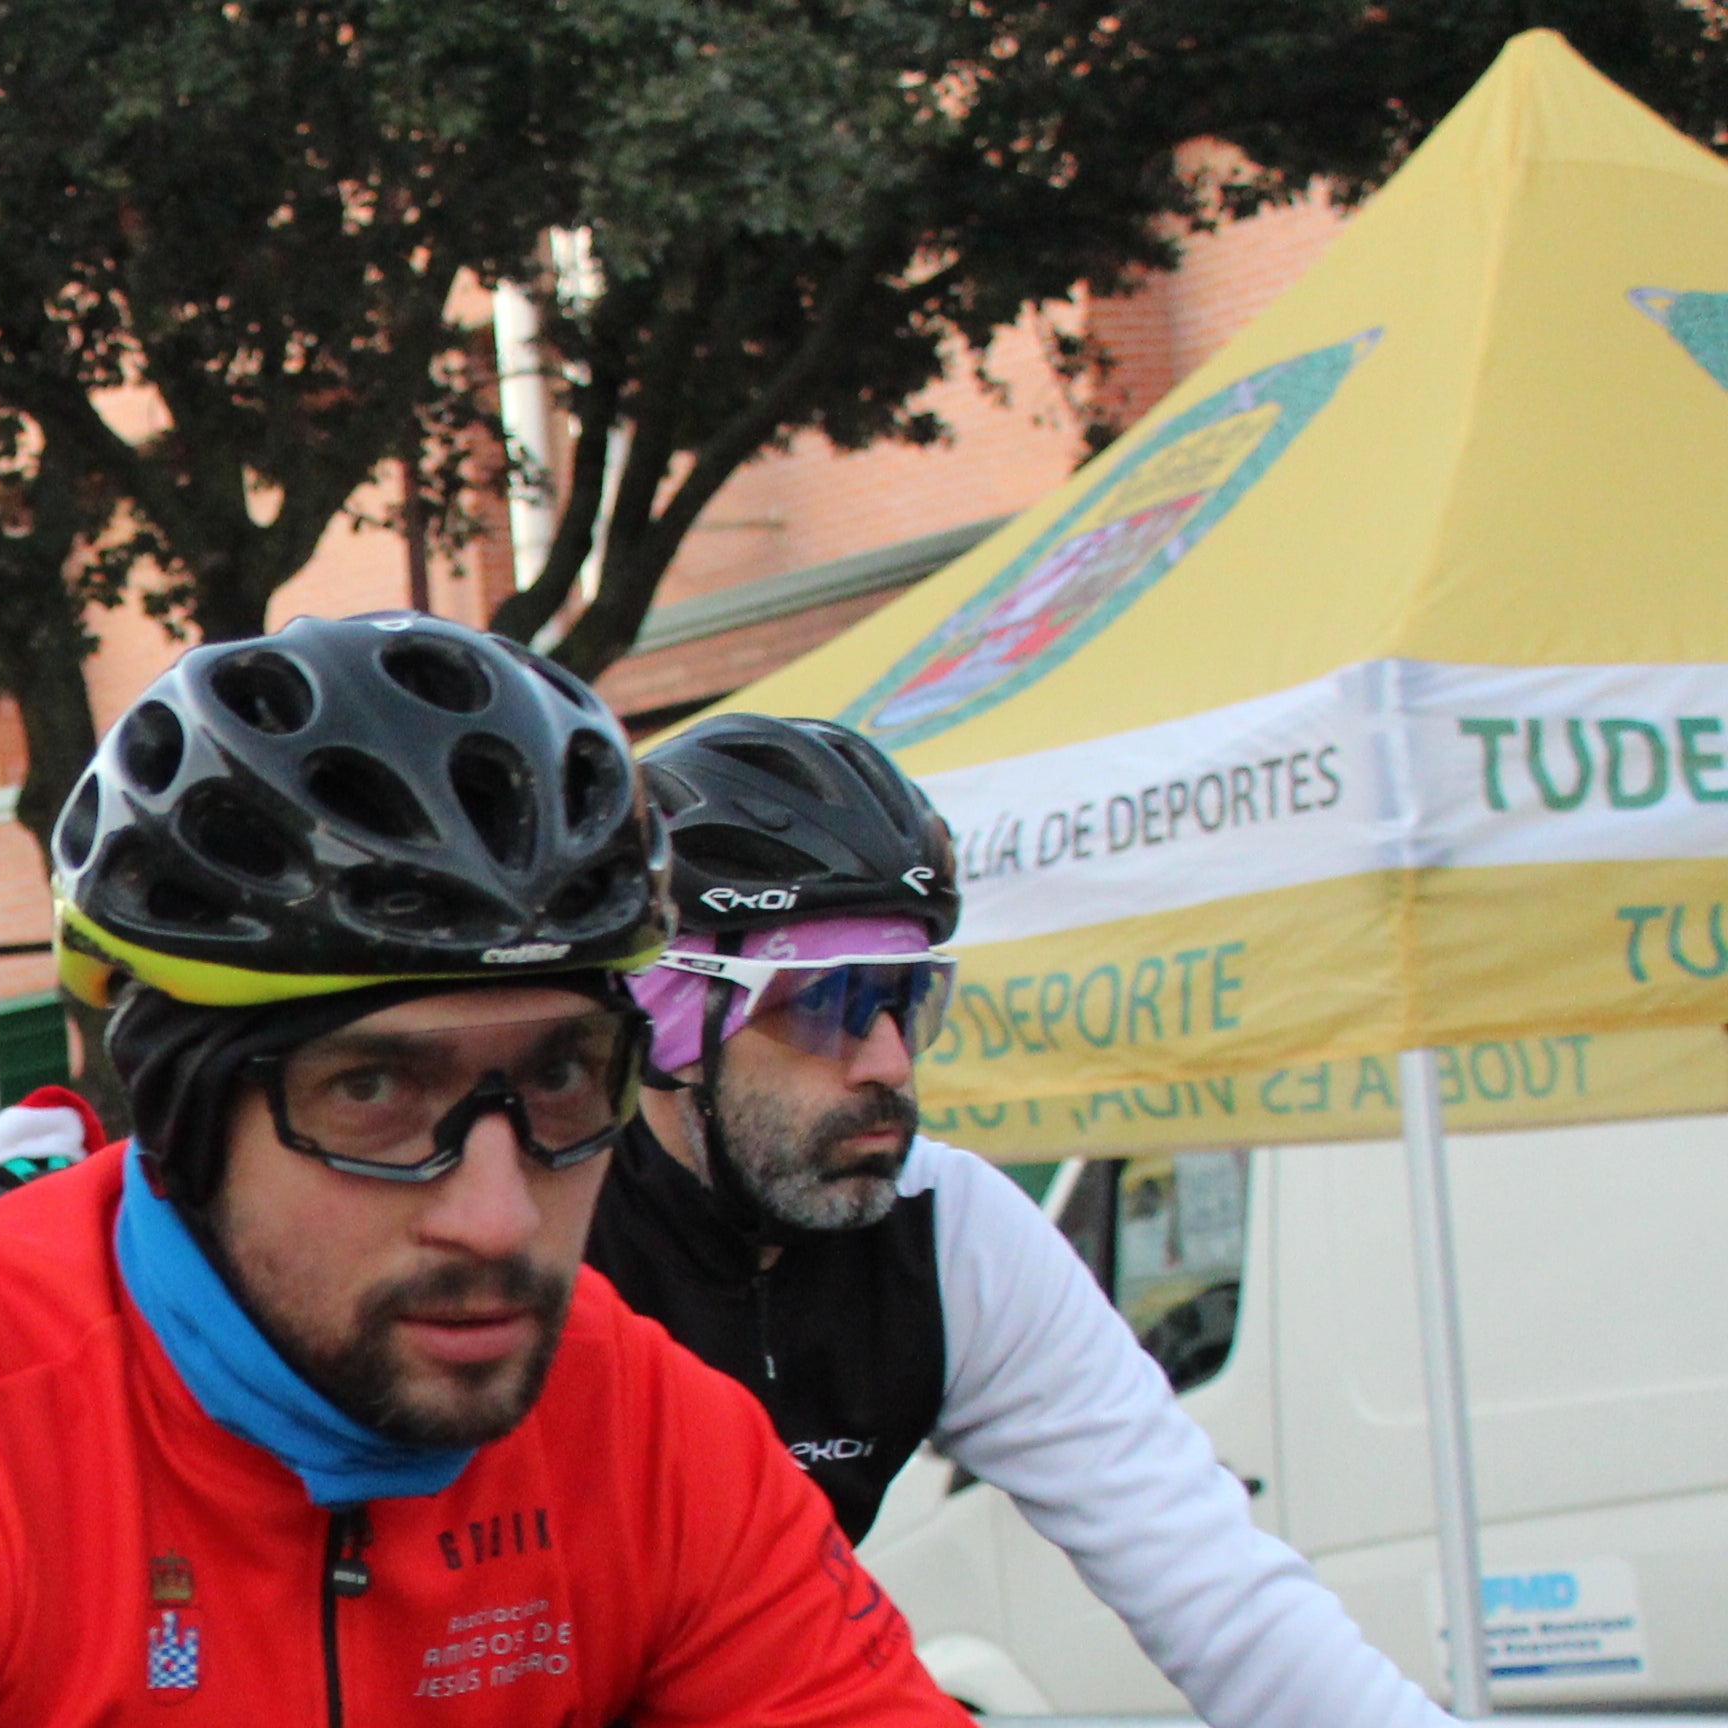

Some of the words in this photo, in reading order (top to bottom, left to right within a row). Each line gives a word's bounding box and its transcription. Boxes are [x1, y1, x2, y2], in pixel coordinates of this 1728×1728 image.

[1036, 803, 1095, 869] DE
[1106, 745, 1344, 854] DEPORTES
[960, 940, 1246, 1060] DEPORTE
